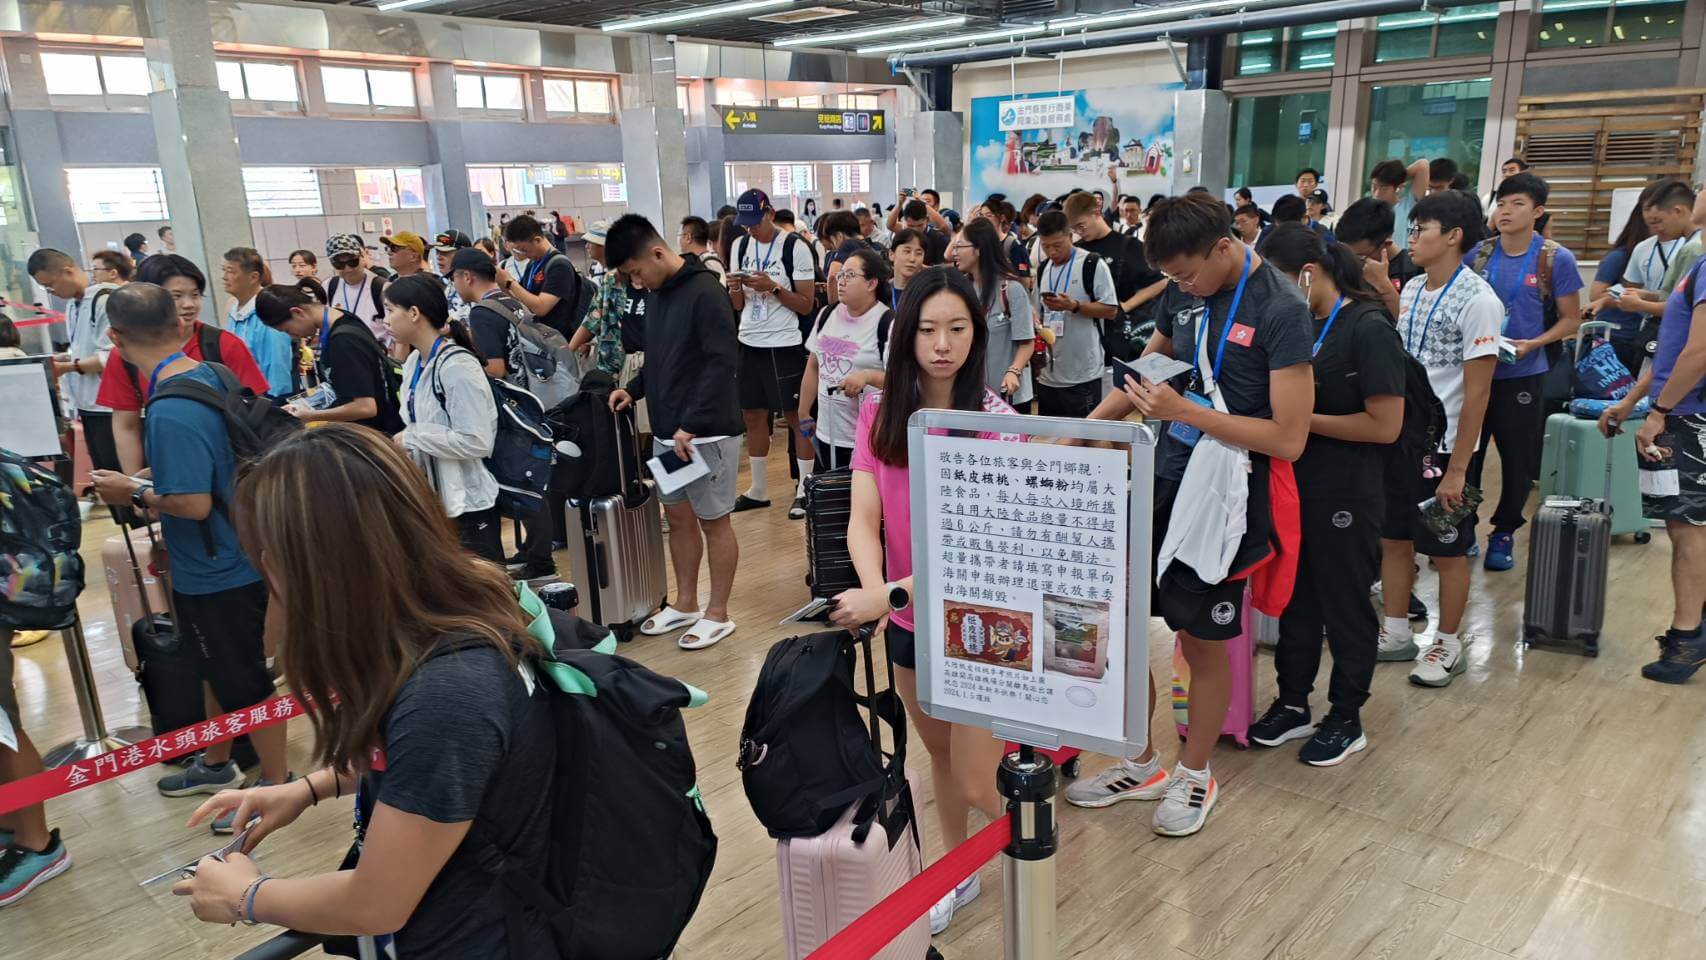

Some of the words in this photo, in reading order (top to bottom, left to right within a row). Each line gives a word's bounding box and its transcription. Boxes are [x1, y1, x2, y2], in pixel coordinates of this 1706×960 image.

[64, 691, 341, 788] 金門港水頭旅客服務
